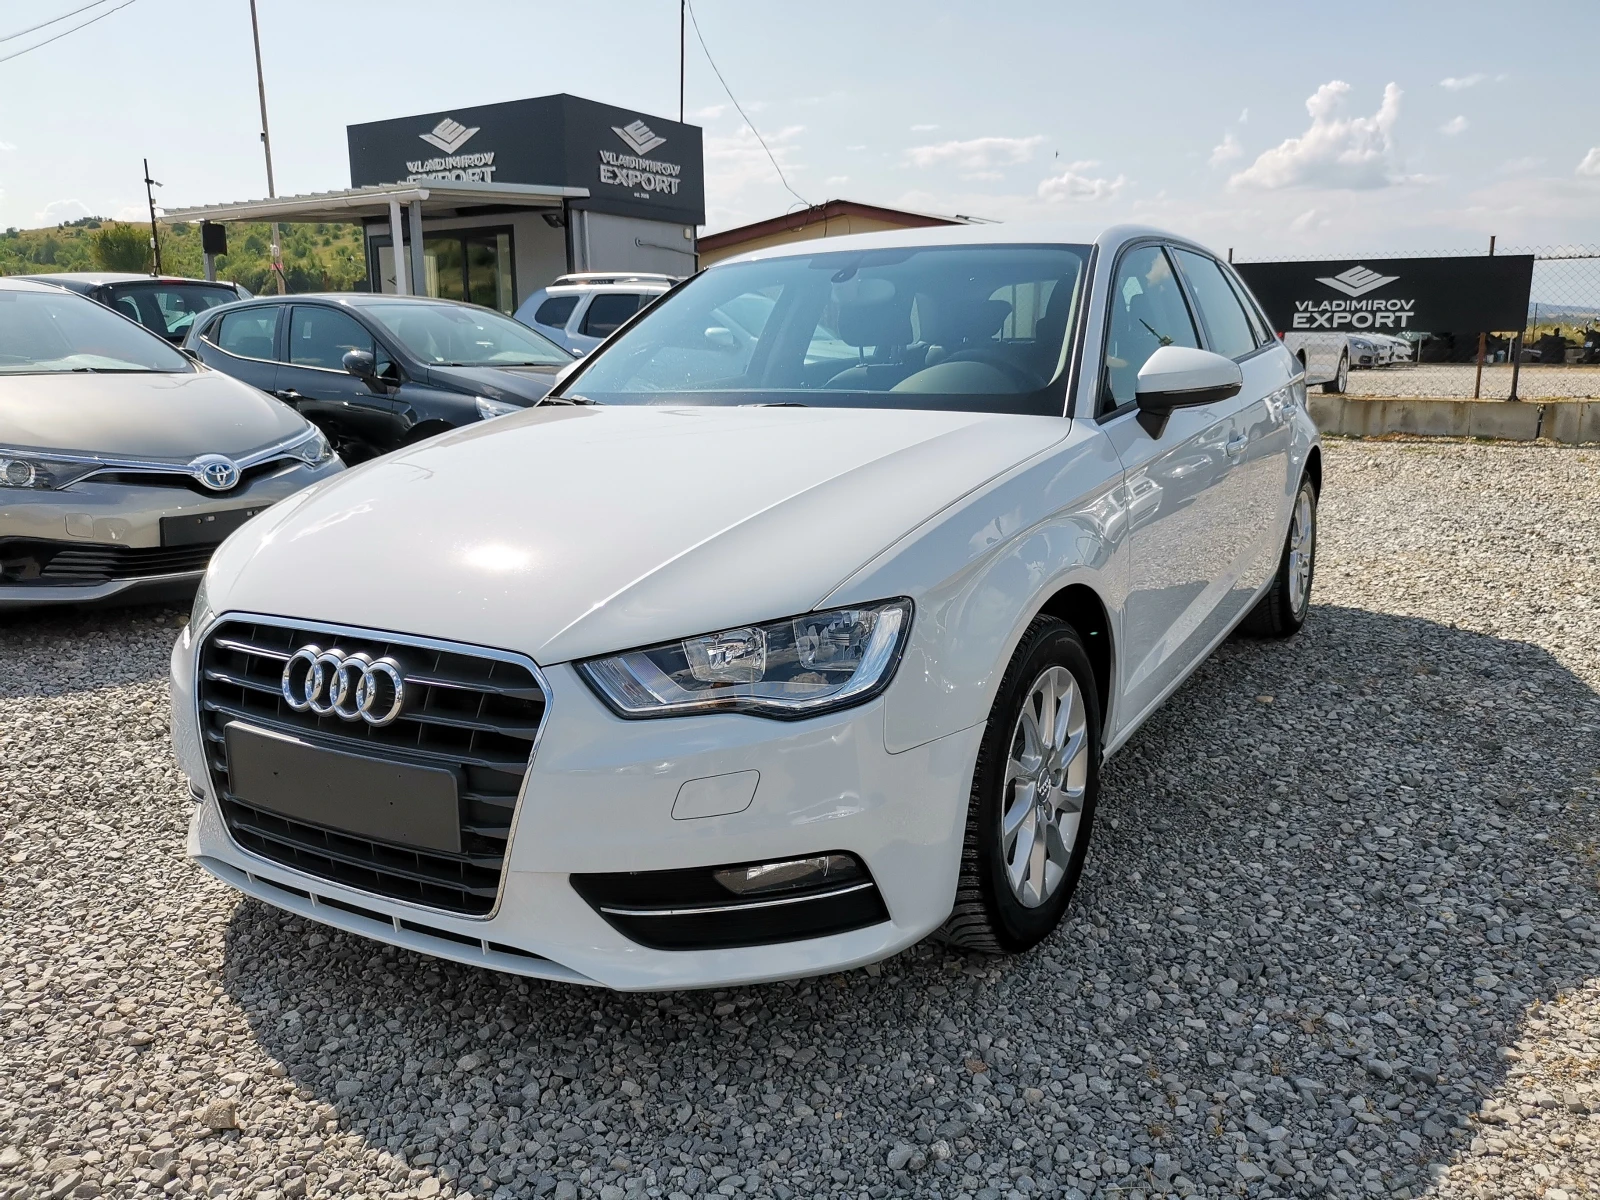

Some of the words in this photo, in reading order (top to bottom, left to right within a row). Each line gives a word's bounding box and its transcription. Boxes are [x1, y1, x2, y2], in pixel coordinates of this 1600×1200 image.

[599, 150, 681, 176] VLADIMIROV
[600, 164, 681, 195] EXPORT
[1295, 299, 1415, 312] VLADIMIROV
[1292, 311, 1415, 328] EXPORT
